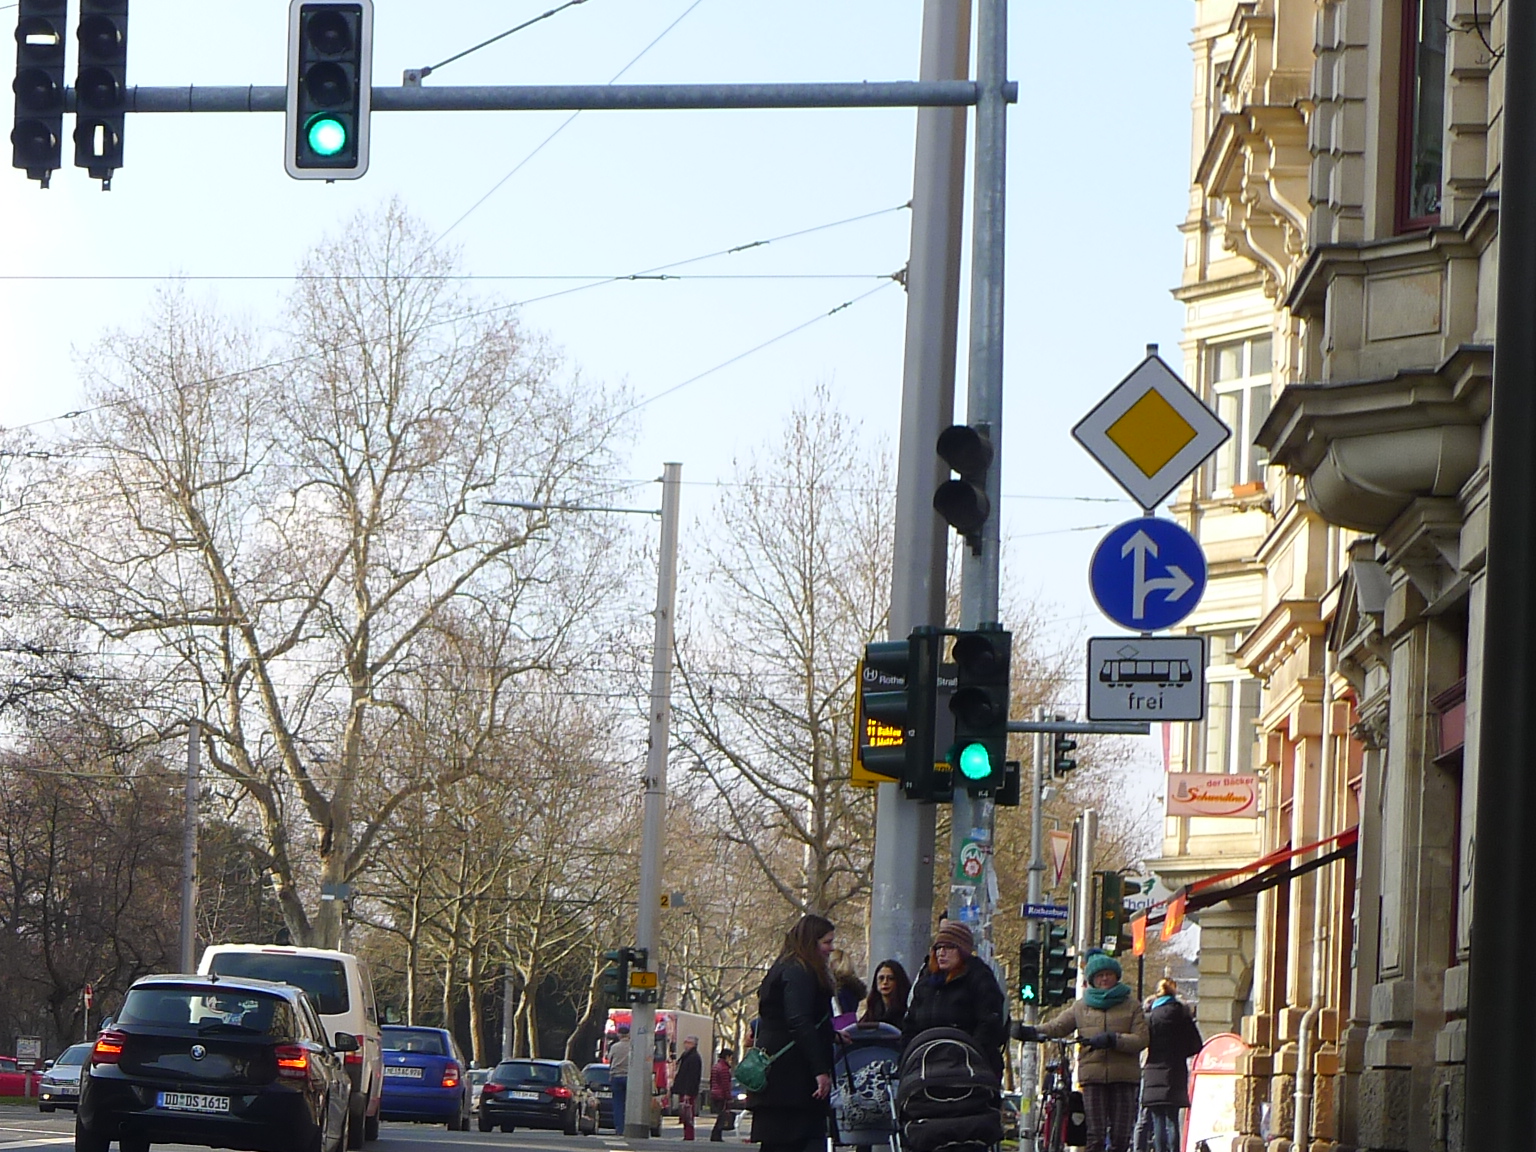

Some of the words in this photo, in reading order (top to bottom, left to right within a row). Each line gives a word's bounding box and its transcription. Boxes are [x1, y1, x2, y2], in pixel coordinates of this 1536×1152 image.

[1128, 691, 1163, 710] frei
[1224, 777, 1253, 786] Bäcker
[660, 895, 669, 907] 2
[1028, 905, 1068, 918] Rothenburg
[165, 1094, 179, 1105] DD
[185, 1095, 199, 1107] DS
[201, 1097, 228, 1109] 1615
